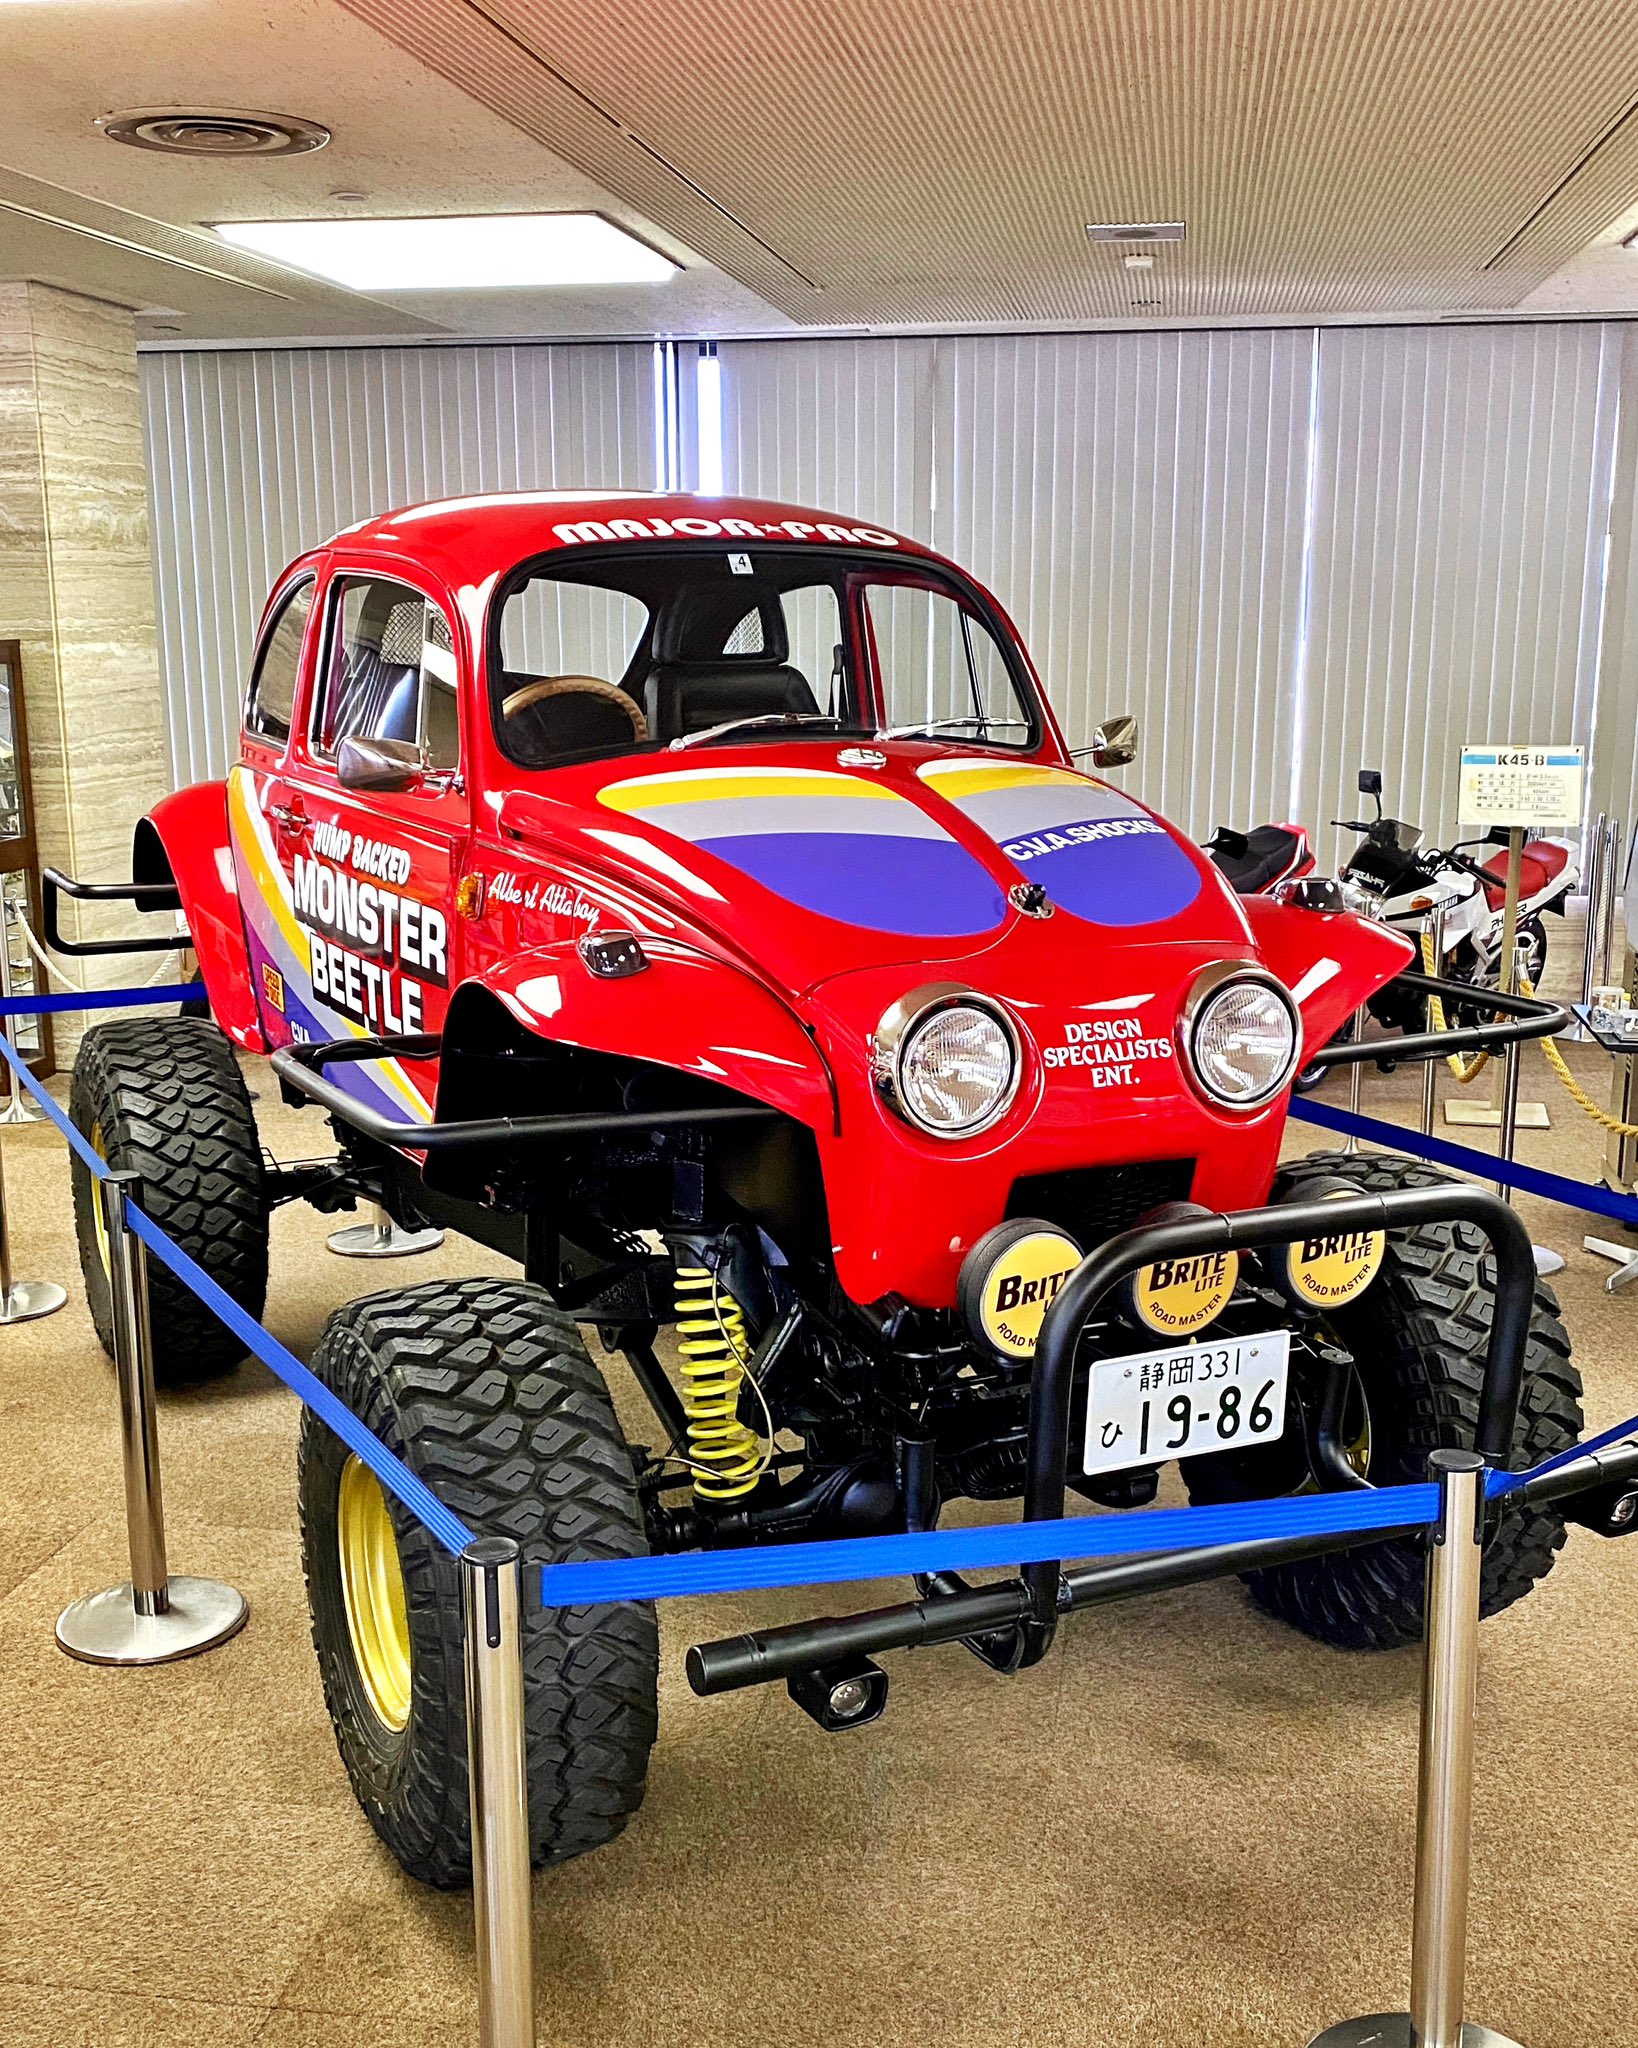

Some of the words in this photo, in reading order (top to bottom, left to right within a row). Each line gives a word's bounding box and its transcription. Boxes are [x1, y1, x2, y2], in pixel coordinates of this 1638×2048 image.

[551, 517, 766, 545] MAJOR
[780, 521, 899, 546] PRO
[313, 821, 351, 863] HUMP
[352, 835, 410, 885] BACKED
[294, 853, 447, 976] MONSTER
[487, 872, 539, 909] Albert
[539, 883, 600, 933] Attaboy
[311, 934, 424, 1036] BEETLE
[1064, 1018, 1143, 1043] DESIGN
[1043, 1038, 1172, 1068] SPECIALISTS
[1091, 1064, 1140, 1088] ENT.
[1344, 1243, 1372, 1264] LITE
[1149, 1251, 1228, 1292] BRITE
[1194, 1273, 1225, 1293] LITE
[1302, 1273, 1328, 1296] ROAD
[1330, 1263, 1371, 1296] MASTER
[1149, 1302, 1177, 1325] ROAD
[1178, 1293, 1222, 1326] MASTER
[997, 1322, 1026, 1347] ROAD
[1101, 1421, 1123, 1449] ひ
[1139, 1379, 1275, 1455] 19-86
